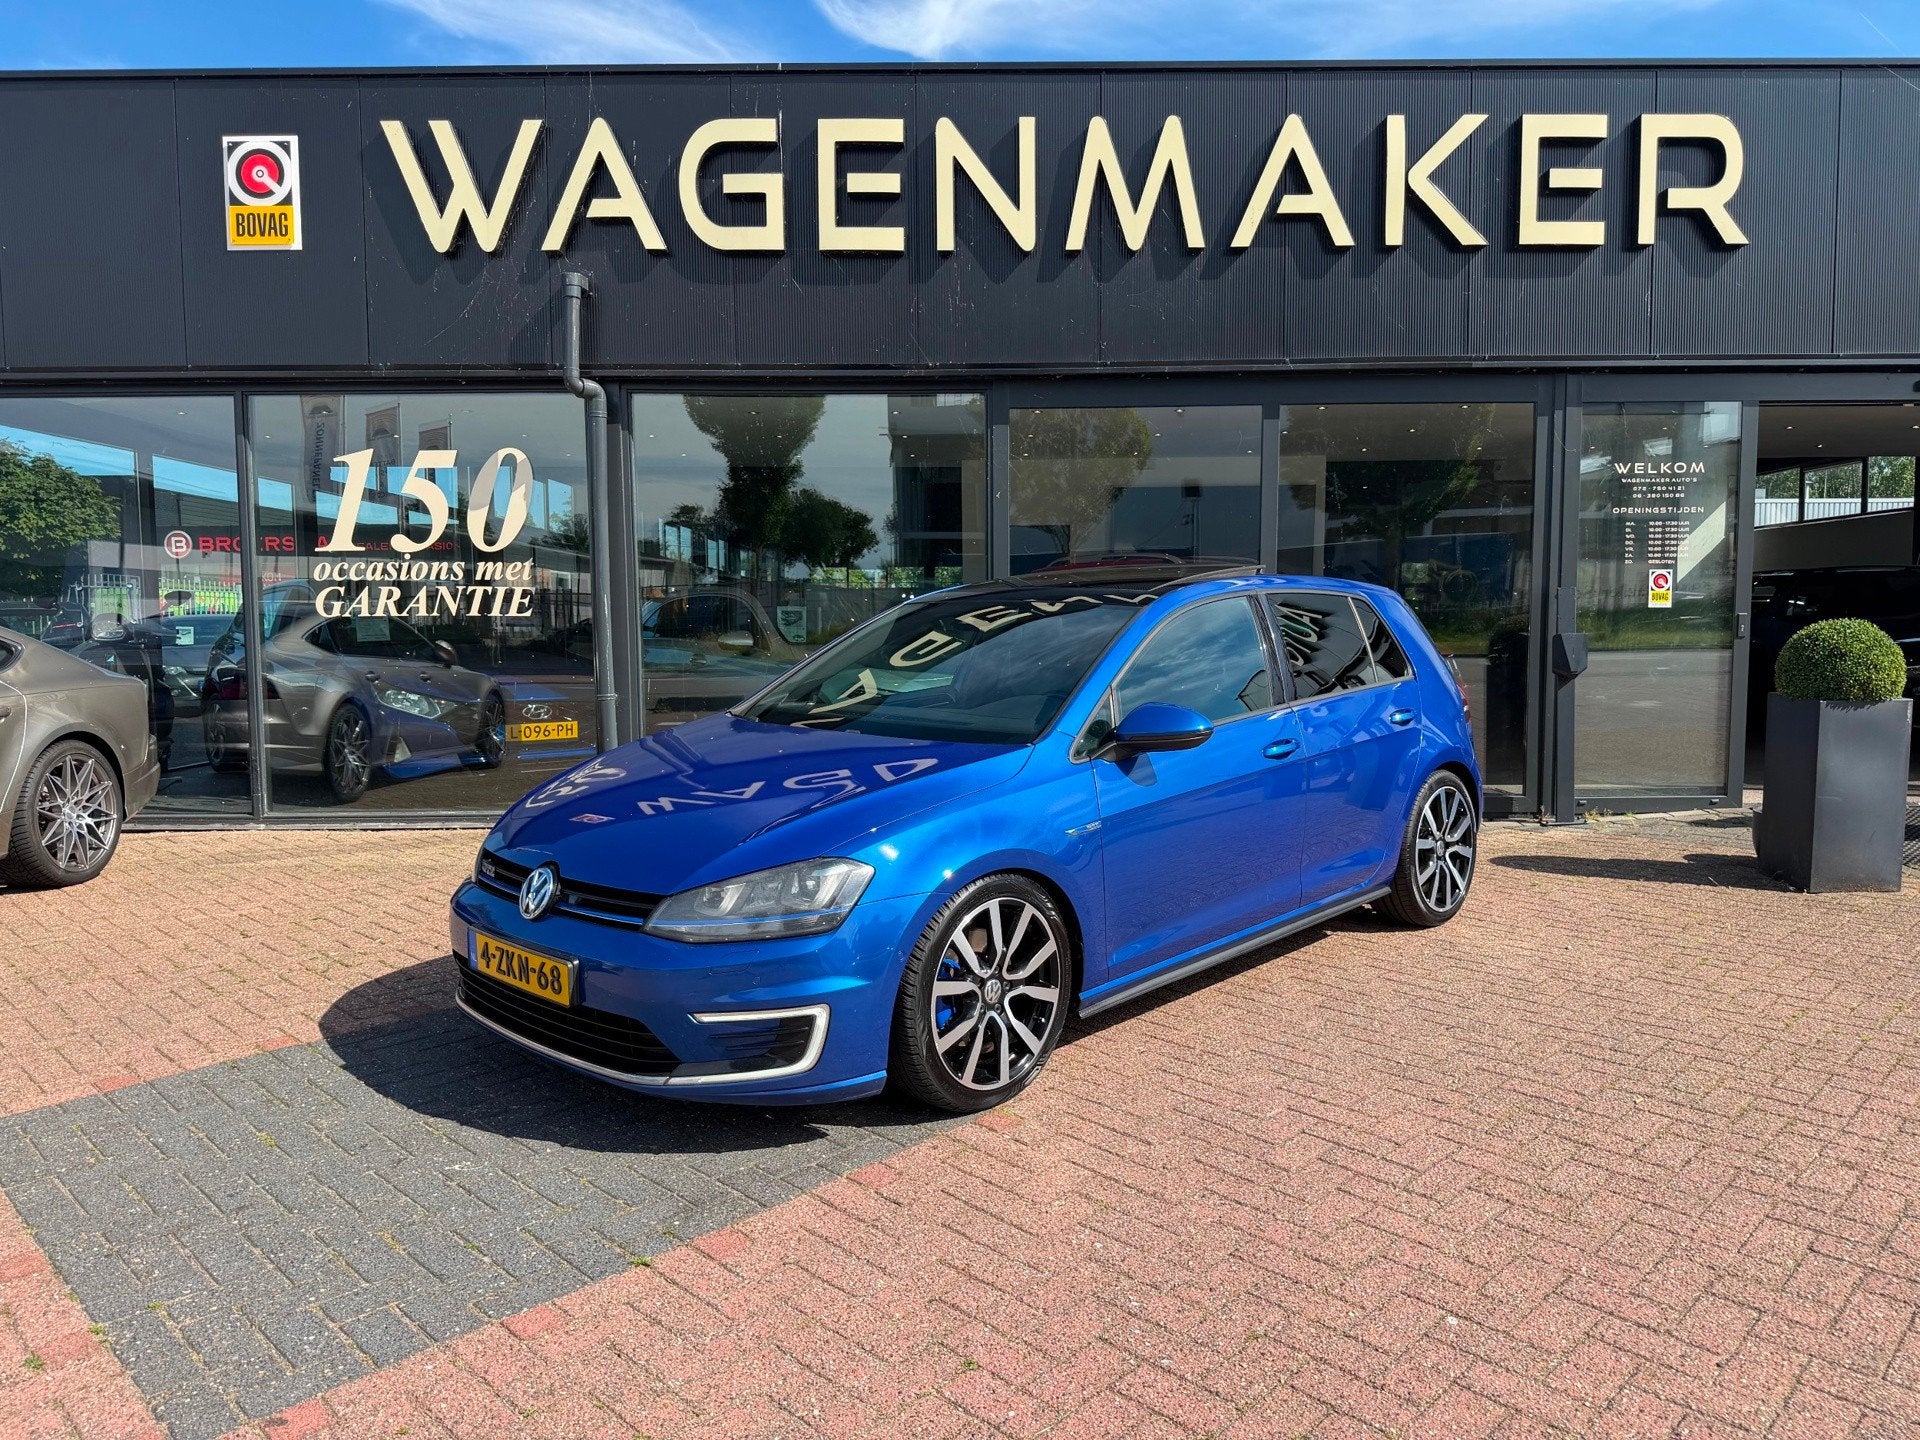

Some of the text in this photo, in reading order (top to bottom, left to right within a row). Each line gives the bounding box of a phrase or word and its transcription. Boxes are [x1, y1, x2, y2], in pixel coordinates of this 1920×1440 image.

[380, 114, 1748, 253] WAGENMAKER
[236, 212, 289, 238] BOVAG
[1614, 462, 1705, 474] WELKOM
[315, 447, 534, 553] 150
[1612, 506, 1705, 514] OPENINGSTIJDEN
[313, 554, 535, 582] occasions met
[315, 585, 536, 618] GARANTIE
[1651, 592, 1669, 601] BOVAG
[509, 723, 574, 739] L-096-PH
[480, 941, 562, 995] 4-ZKN-68
